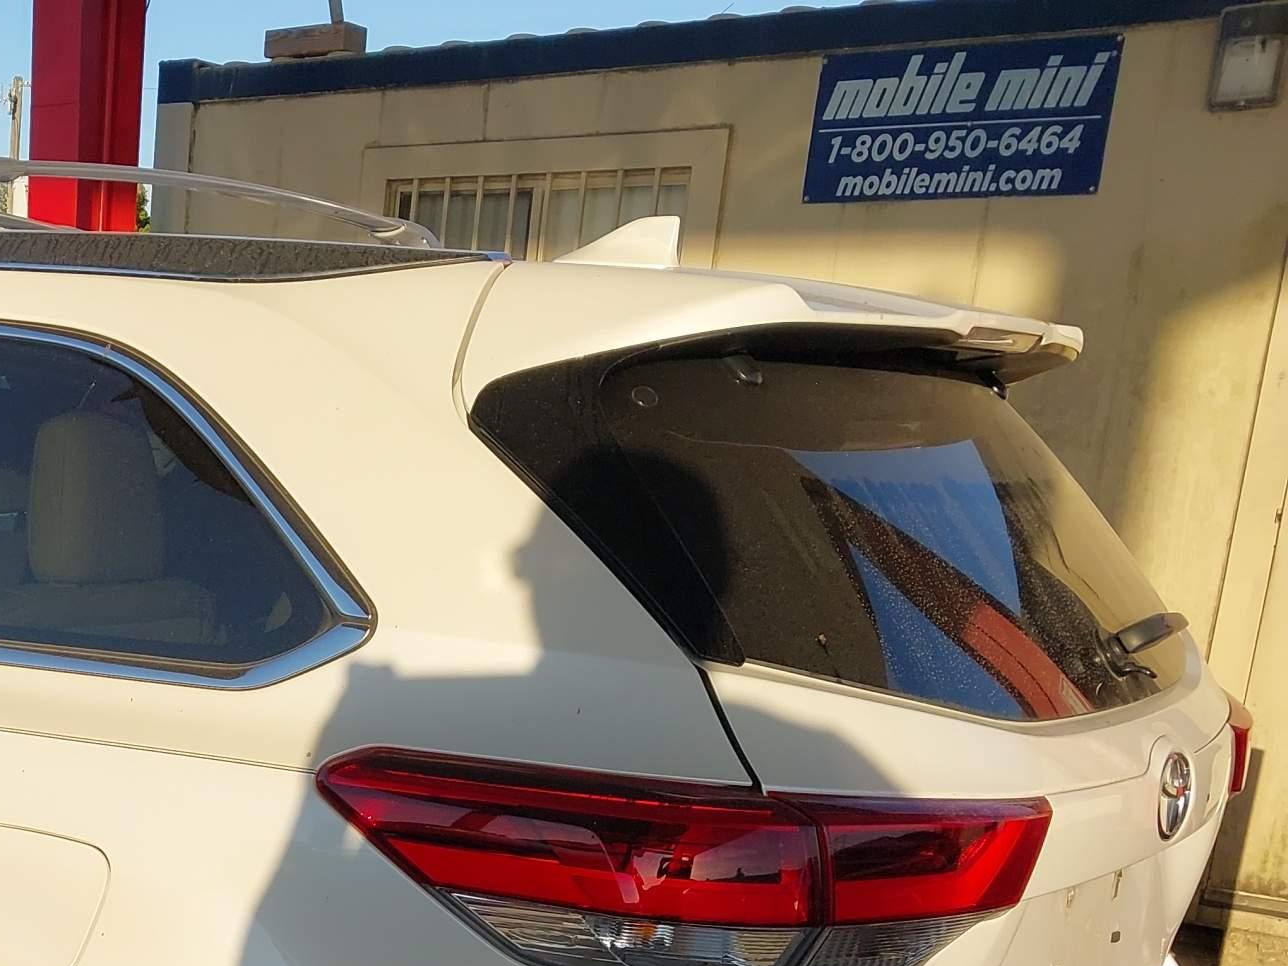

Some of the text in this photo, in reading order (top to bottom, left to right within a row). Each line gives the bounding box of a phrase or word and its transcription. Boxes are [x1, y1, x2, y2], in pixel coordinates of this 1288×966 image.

[822, 51, 1111, 121] mobile mini
[828, 123, 1085, 164] 1-800-950-6464
[835, 164, 1063, 197] mobilemini.com
